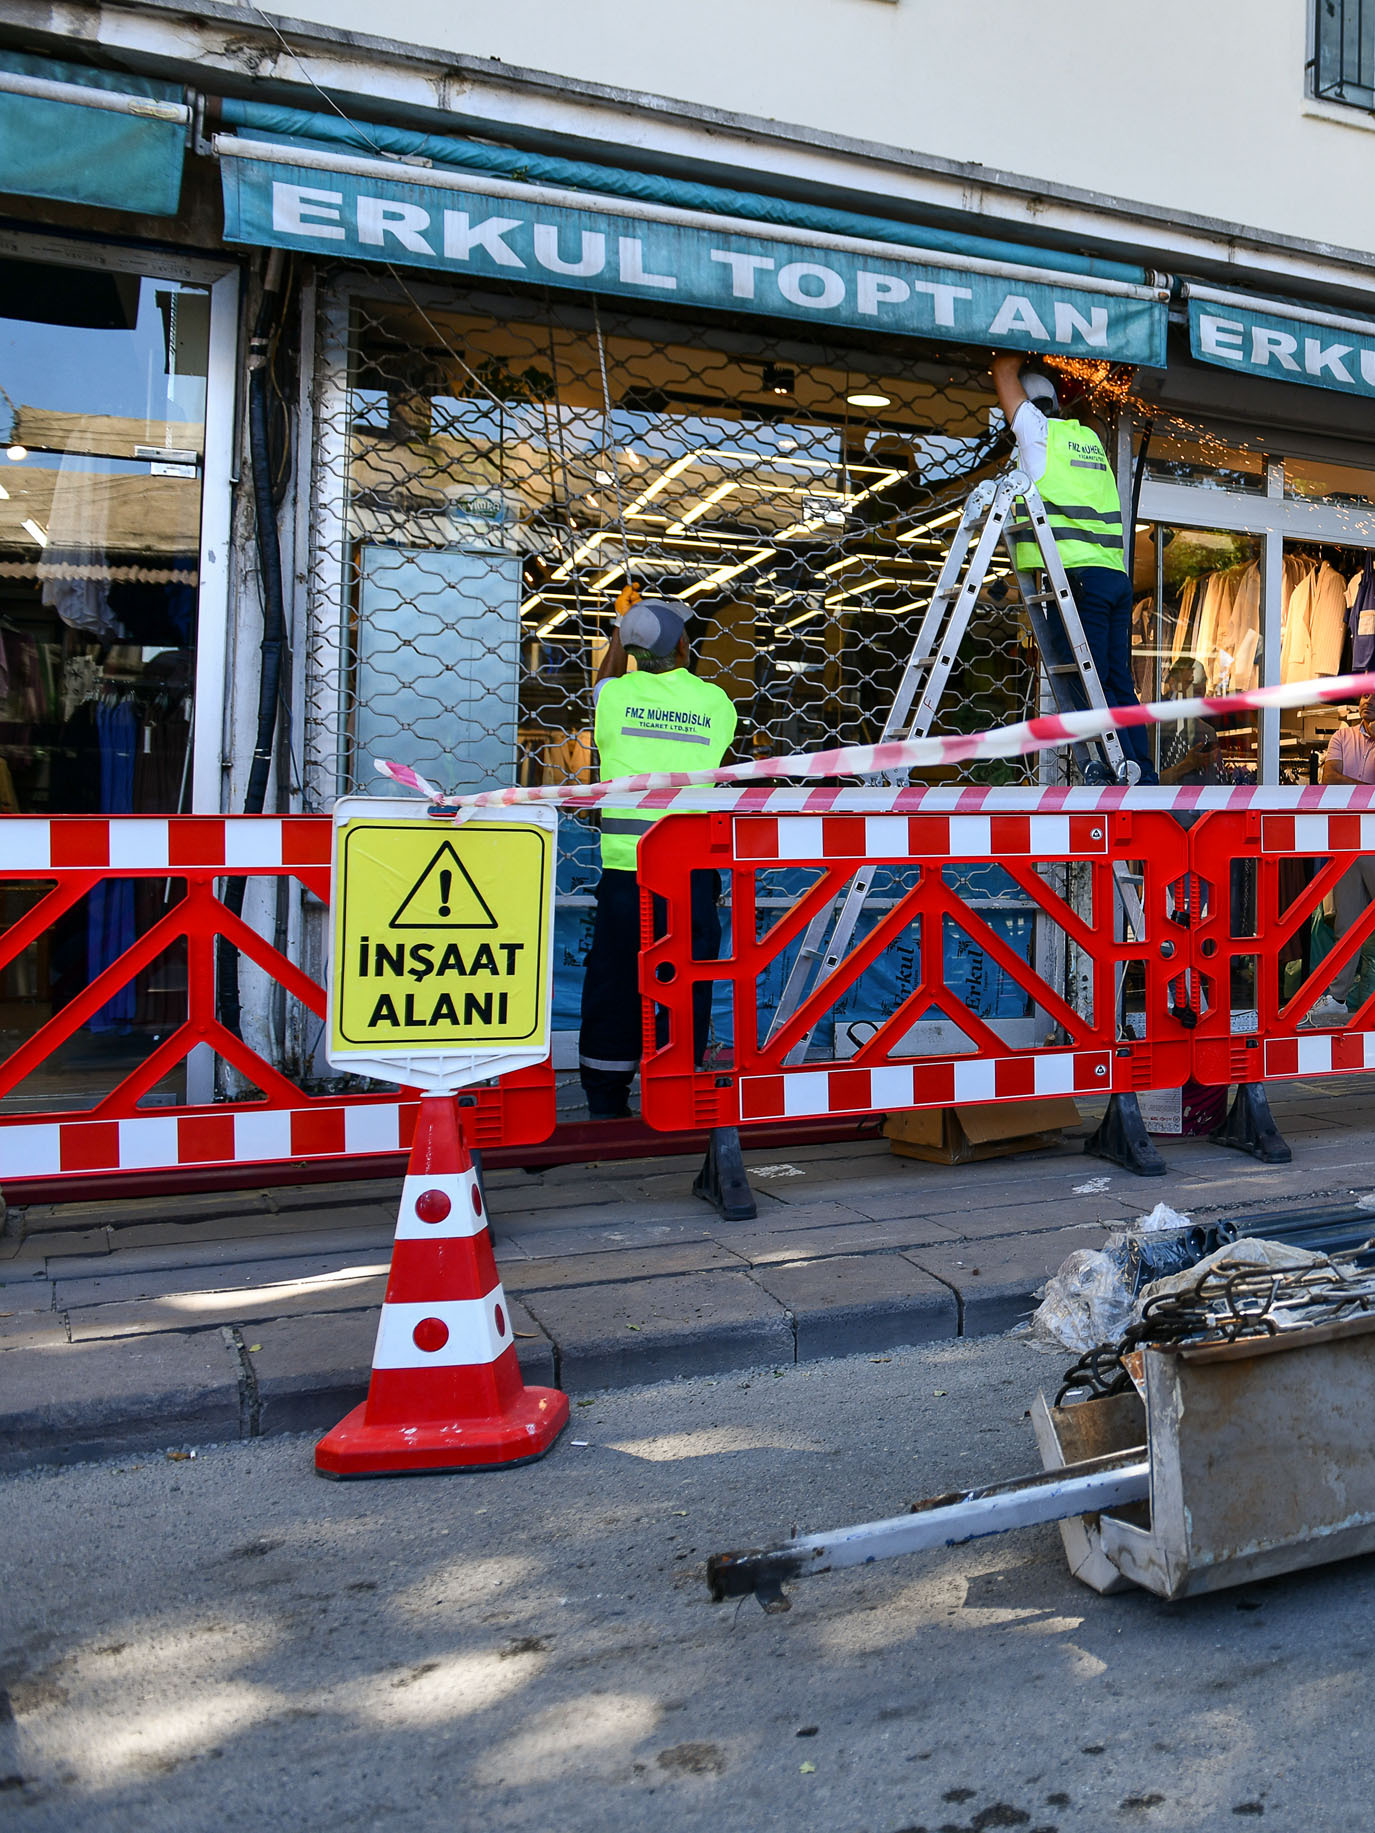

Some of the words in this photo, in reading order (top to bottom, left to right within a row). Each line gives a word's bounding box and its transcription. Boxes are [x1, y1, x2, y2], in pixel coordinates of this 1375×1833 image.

[272, 181, 678, 290] ERKUL
[710, 249, 1109, 348] TOPTAN
[625, 706, 645, 719] FMZ
[647, 708, 711, 728] MÜHENDİSLİK
[358, 936, 525, 982] İNŞAAT
[965, 949, 984, 1011] Erkul
[367, 992, 509, 1028] ALANI
